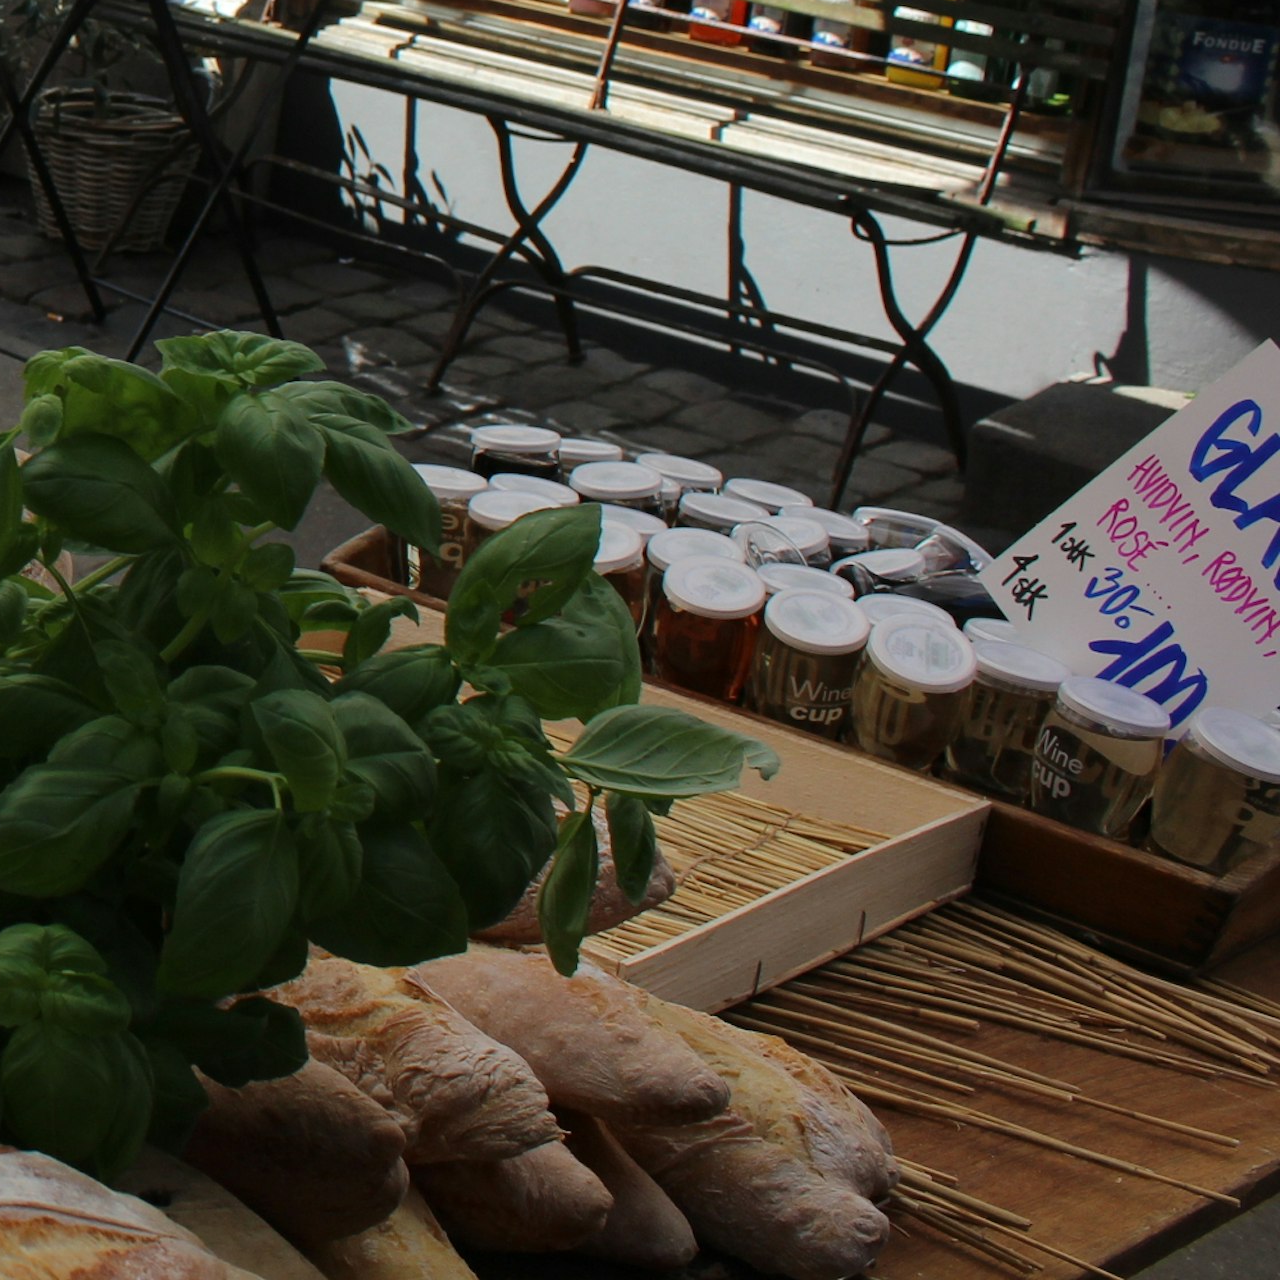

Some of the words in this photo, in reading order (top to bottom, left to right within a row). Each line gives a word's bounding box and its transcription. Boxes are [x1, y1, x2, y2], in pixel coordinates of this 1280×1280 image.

[1193, 31, 1267, 55] FONDUE
[789, 676, 853, 702] Wine
[789, 706, 844, 726] cup
